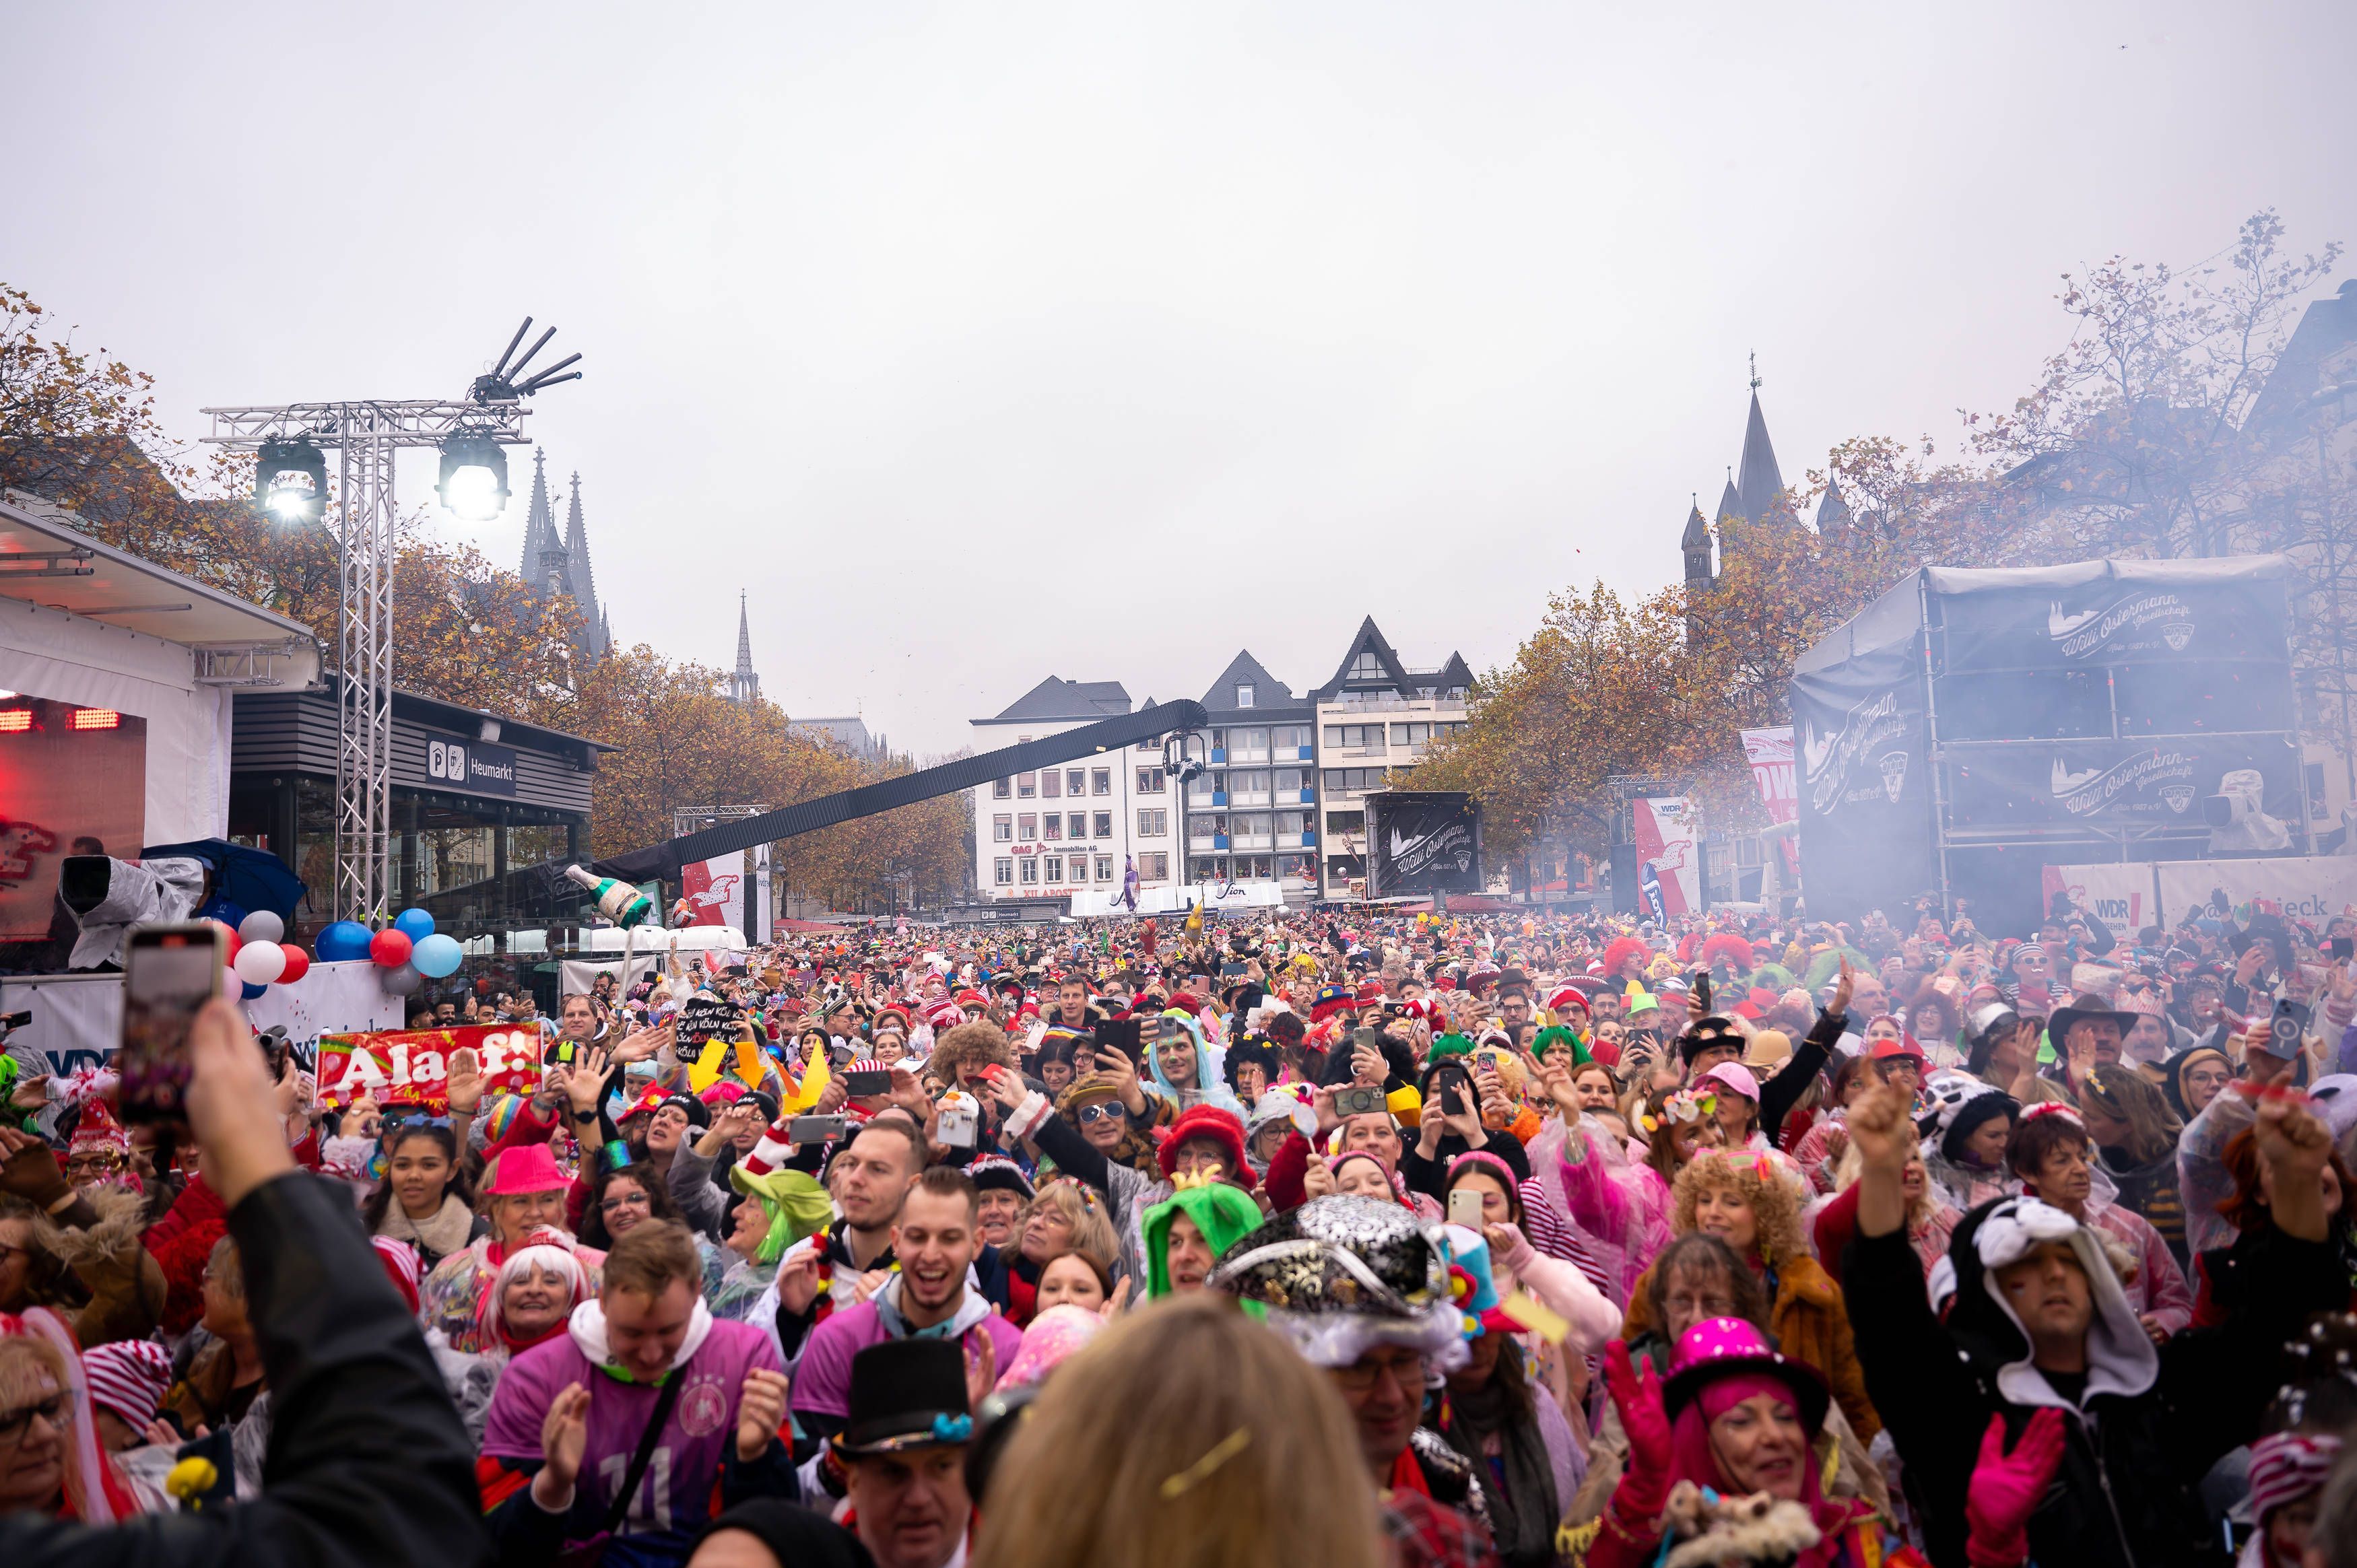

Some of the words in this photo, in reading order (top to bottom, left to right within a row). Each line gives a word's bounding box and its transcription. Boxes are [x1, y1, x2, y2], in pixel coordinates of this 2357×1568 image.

[2061, 627, 2098, 656] Willi
[2100, 594, 2179, 639] Ostermann
[471, 758, 512, 781] Heumarkt
[2135, 765, 2193, 792] Gesellschaft
[2066, 786, 2103, 813] Willi
[2105, 753, 2183, 798] Ostermann
[1011, 846, 1032, 854] GAG
[1398, 849, 1425, 873] Willi
[1426, 825, 1465, 858] Ostermann
[1024, 890, 1038, 898] XII
[1216, 882, 1246, 899] Sion
[2095, 899, 2129, 918] WDR
[700, 1017, 721, 1029] KÖLN
